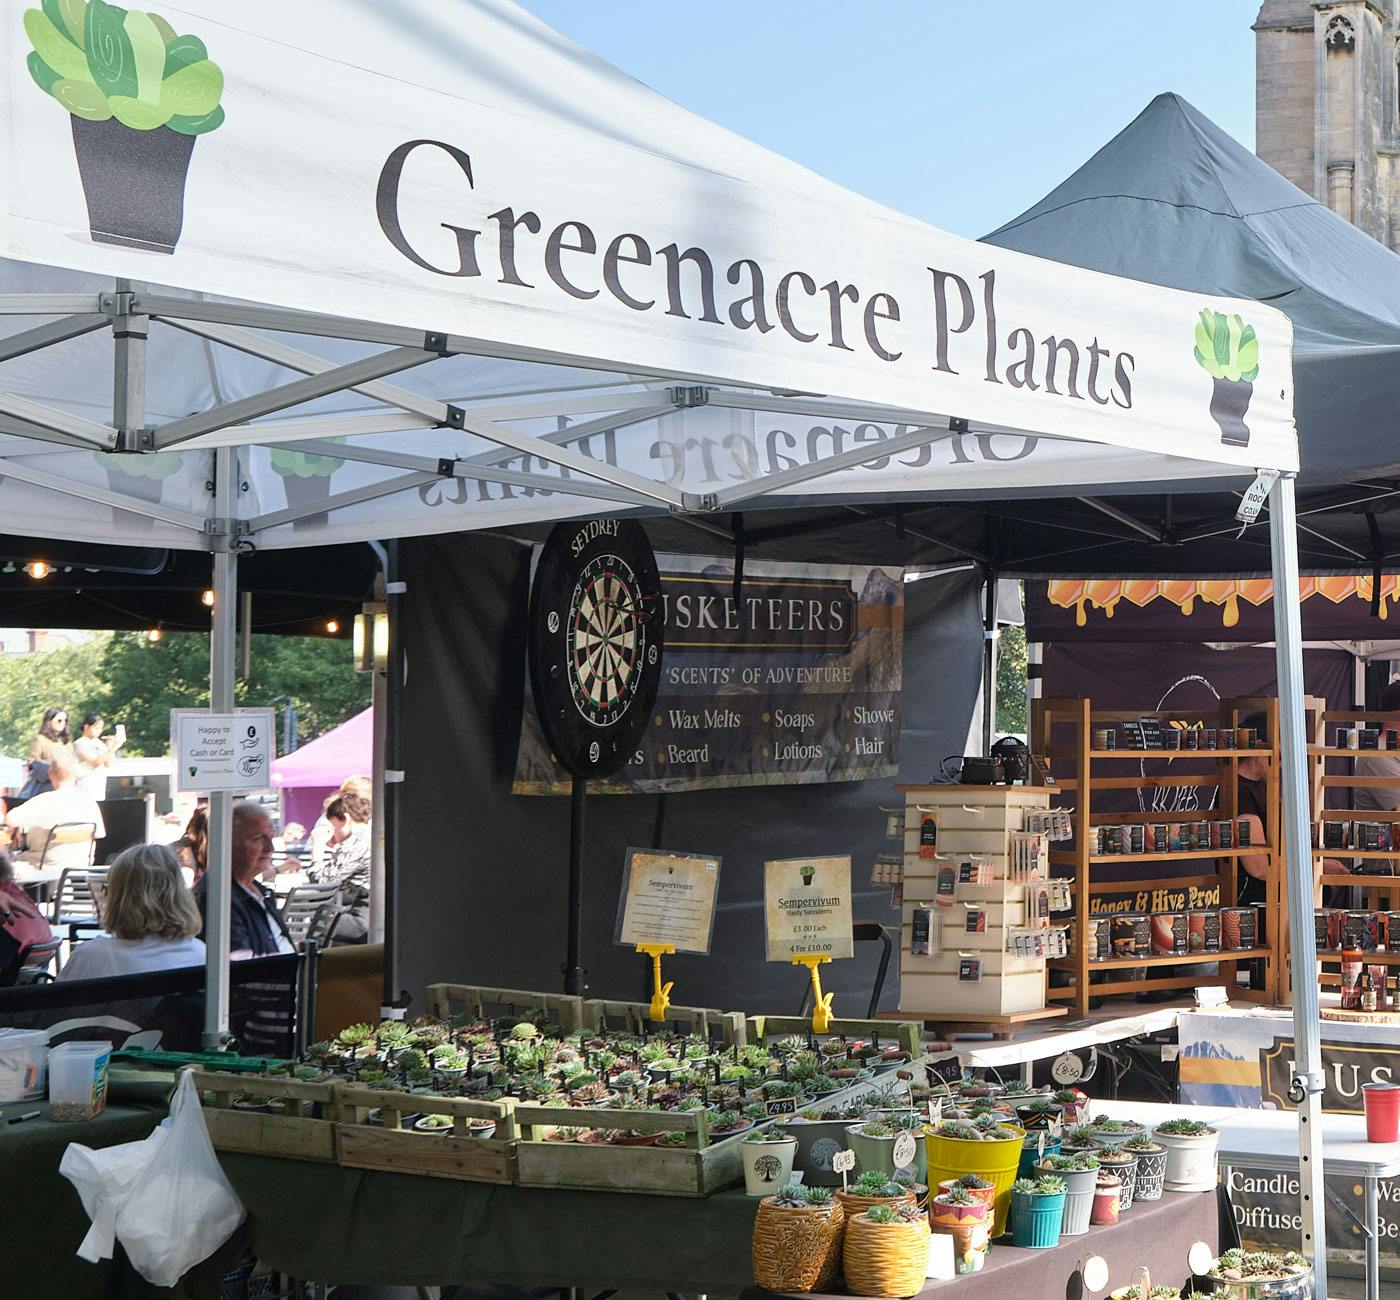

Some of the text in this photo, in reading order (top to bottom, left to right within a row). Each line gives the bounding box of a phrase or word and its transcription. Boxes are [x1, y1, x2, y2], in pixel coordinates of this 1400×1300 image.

[376, 139, 1136, 410] Greenacre Plants
[571, 519, 621, 558] SEYDREY
[742, 667, 761, 684] OF
[766, 666, 851, 685] ADVENTURE
[668, 708, 741, 729] Wax Melts
[774, 709, 815, 732] Soaps
[198, 726, 231, 735] Happy to
[202, 738, 227, 746] Accept
[774, 742, 823, 761] Lotions
[855, 737, 884, 755] Hair
[190, 748, 208, 757] Cash
[219, 748, 235, 757] Card
[667, 744, 709, 763] Beard
[778, 896, 840, 909] Sempervivum
[1091, 897, 1132, 914] Honey
[1135, 891, 1148, 912] &
[1151, 888, 1185, 912] Hive
[790, 945, 795, 953] 4
[807, 943, 832, 952] £10.00
[768, 1101, 793, 1115] £9.95
